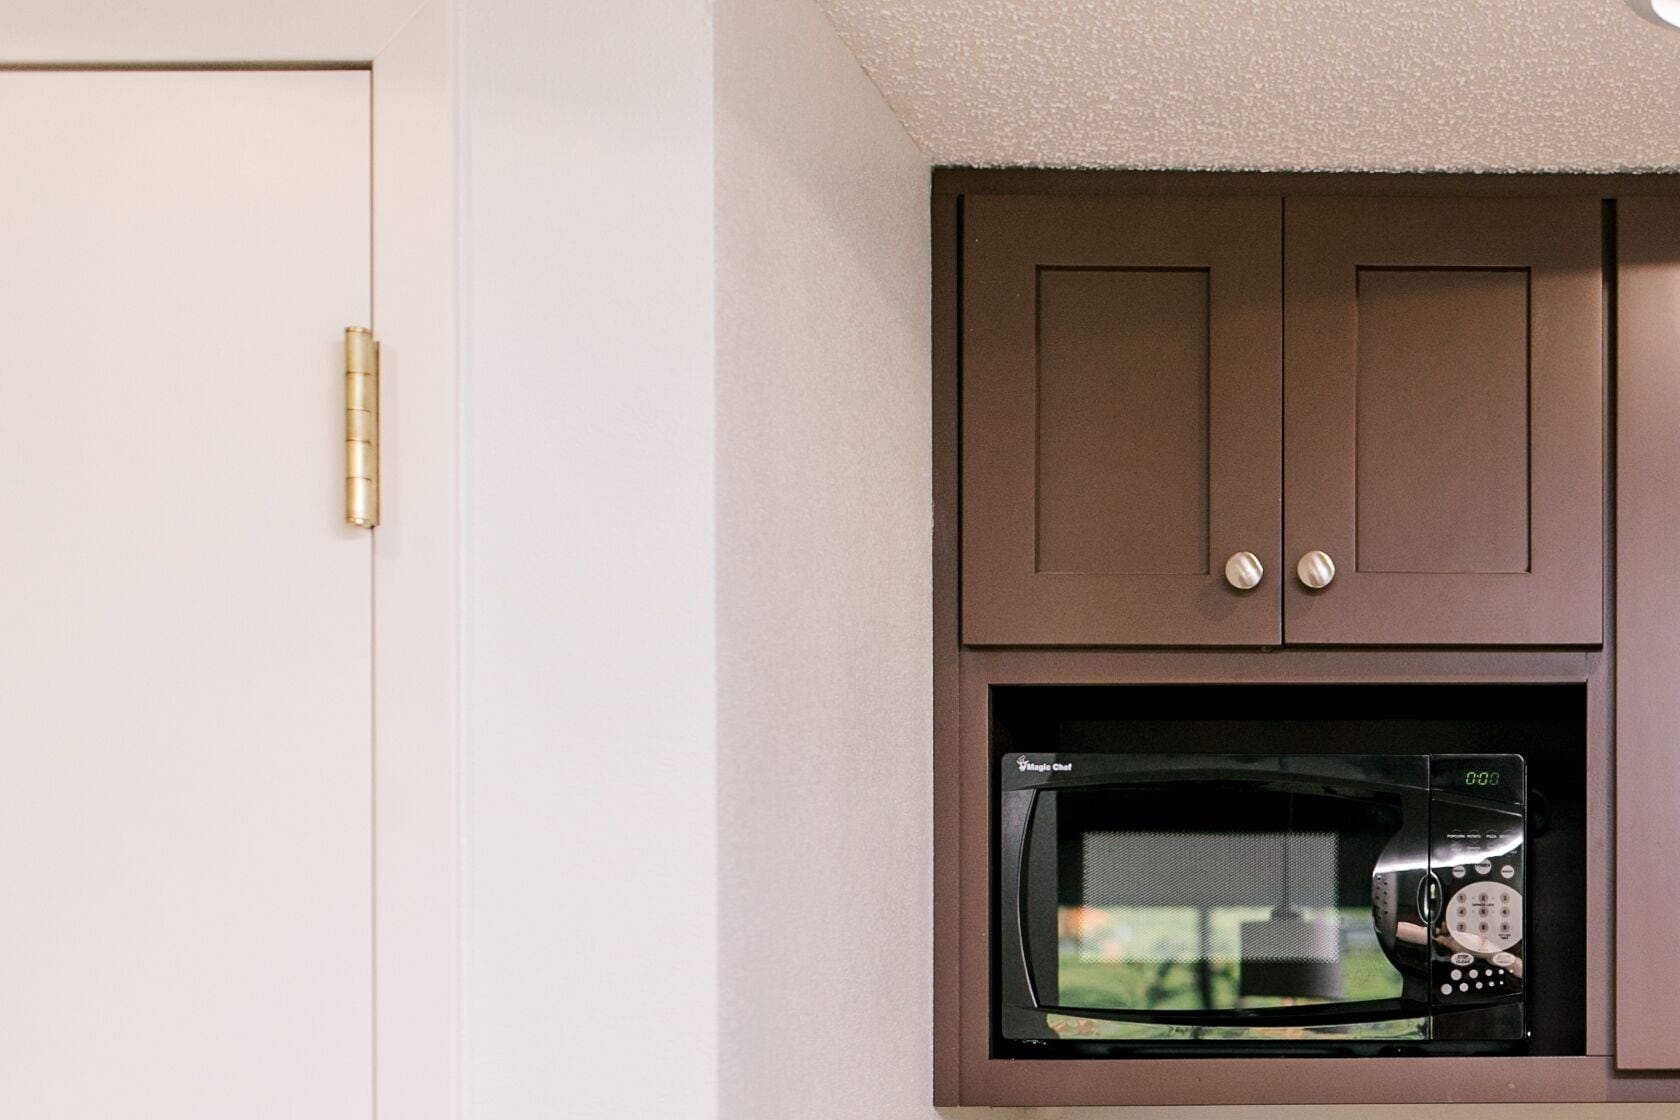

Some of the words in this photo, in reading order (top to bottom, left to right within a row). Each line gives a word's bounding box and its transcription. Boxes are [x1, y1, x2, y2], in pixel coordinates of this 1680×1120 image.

[1026, 763, 1051, 772] Magic
[1052, 763, 1072, 771] Chef
[1465, 772, 1500, 786] 0:00
